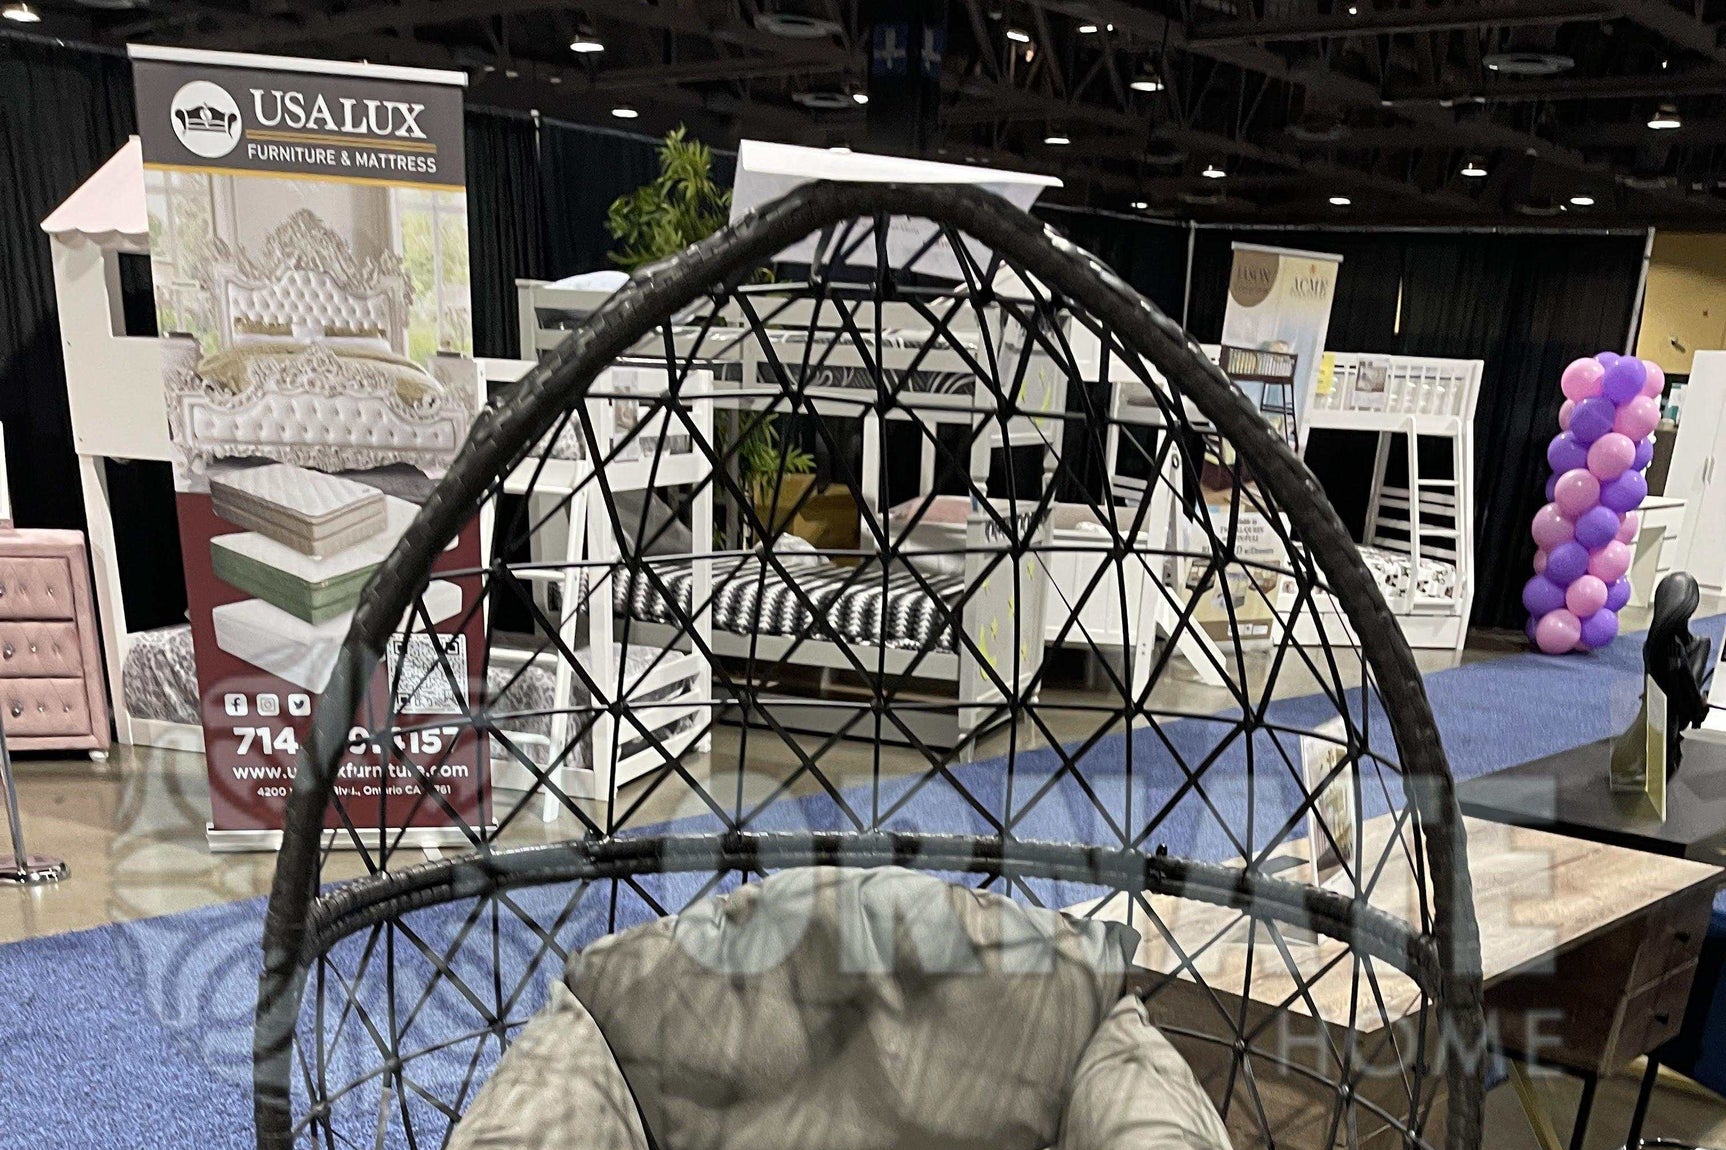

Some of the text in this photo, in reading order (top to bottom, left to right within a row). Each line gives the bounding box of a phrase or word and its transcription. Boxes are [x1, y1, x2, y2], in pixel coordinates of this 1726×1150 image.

[249, 88, 428, 139] USALUX
[247, 143, 437, 173] FURNITURE & MATTRESS
[257, 786, 287, 797] 4200
[405, 785, 422, 795] CA
